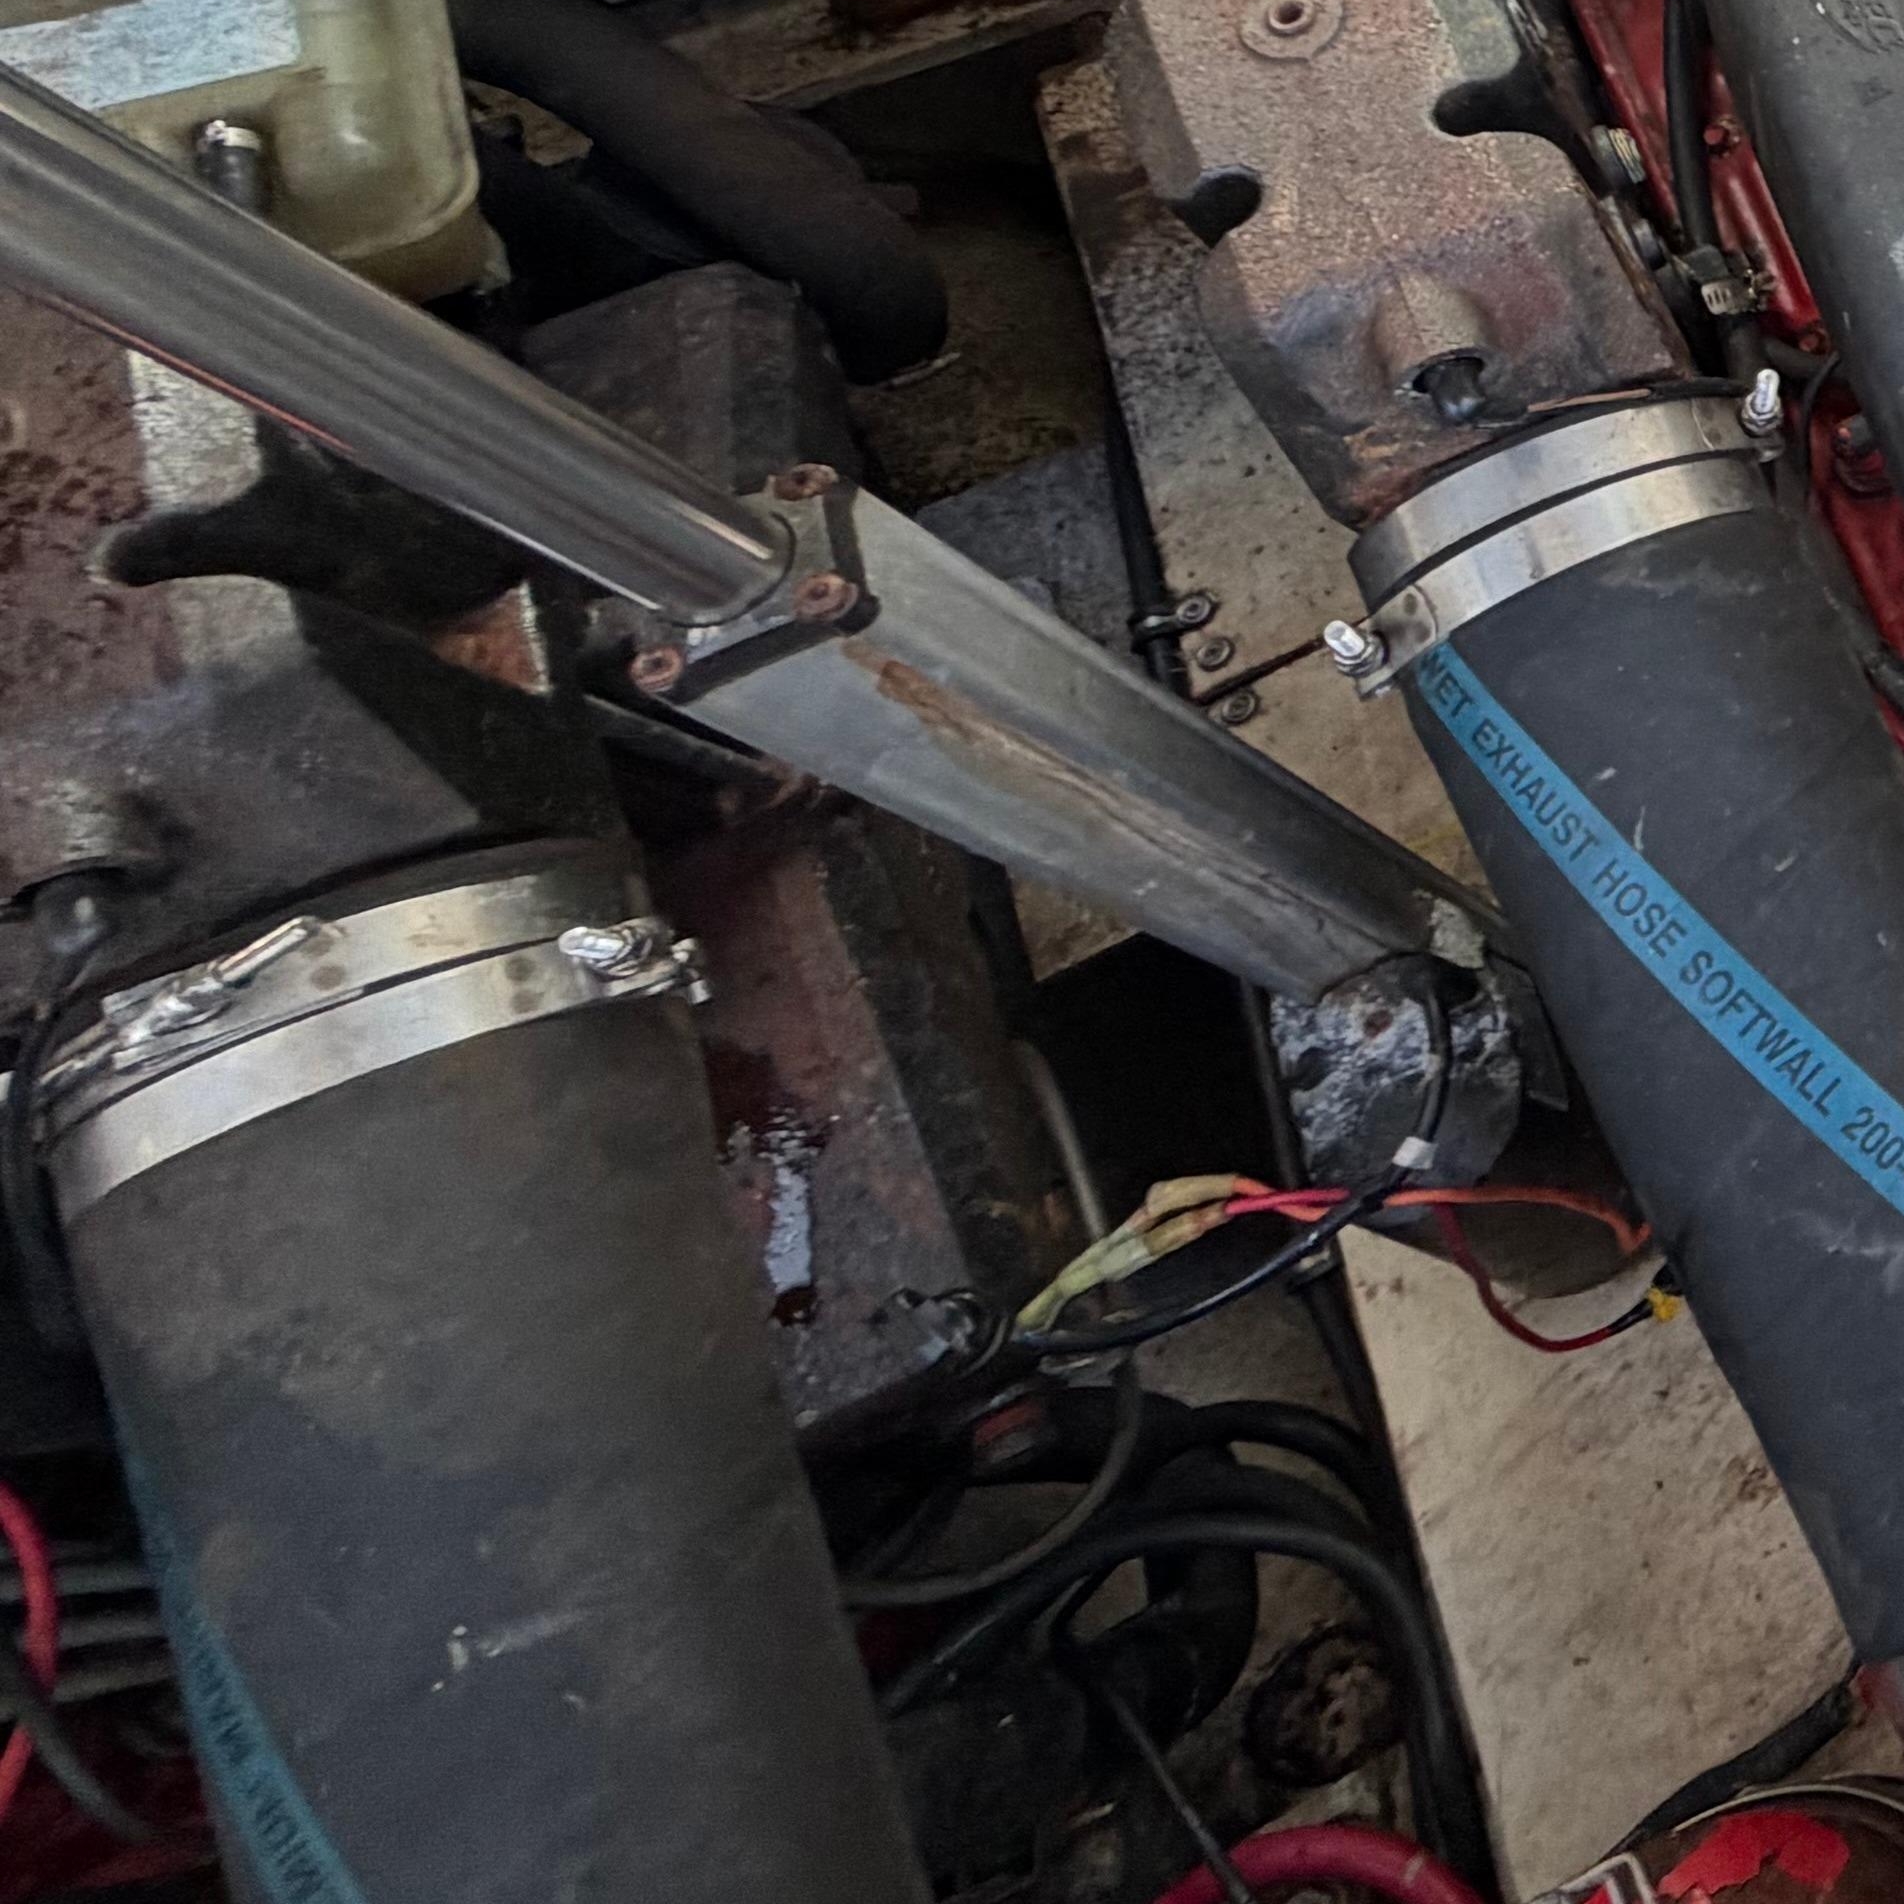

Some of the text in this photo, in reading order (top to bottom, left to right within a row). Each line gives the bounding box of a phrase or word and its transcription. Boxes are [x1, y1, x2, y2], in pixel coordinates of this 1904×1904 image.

[1468, 719, 1597, 863] EXHAUST
[1588, 857, 1688, 959] HOSE
[1676, 950, 1842, 1117] SOFTWALL
